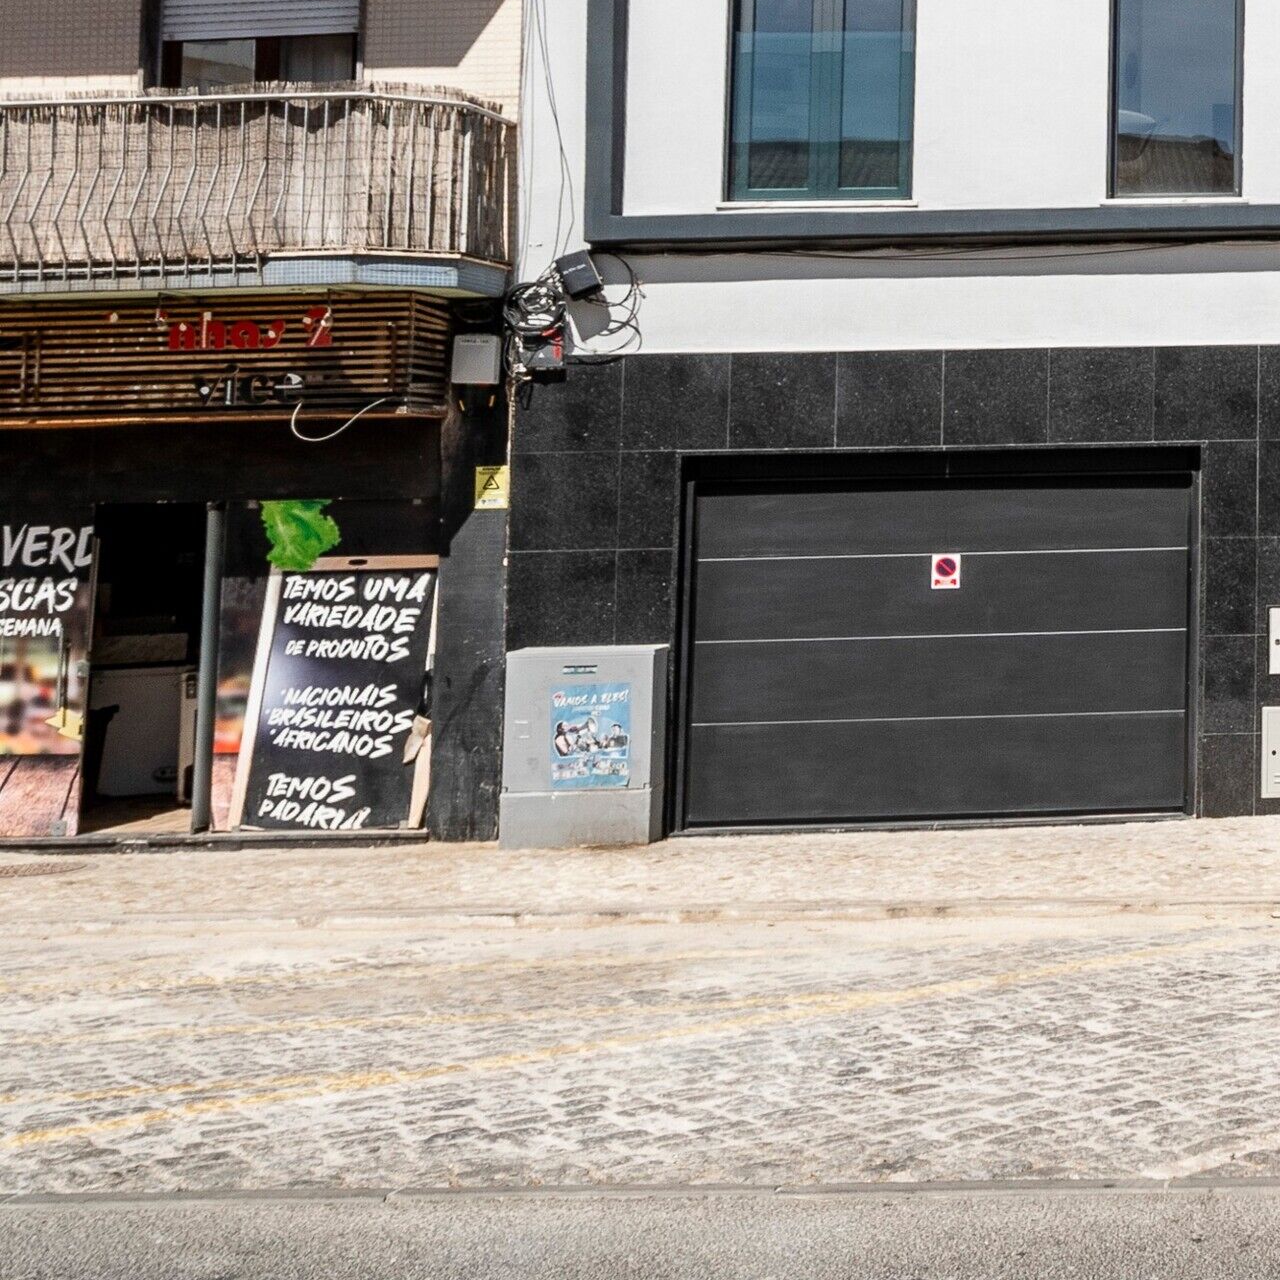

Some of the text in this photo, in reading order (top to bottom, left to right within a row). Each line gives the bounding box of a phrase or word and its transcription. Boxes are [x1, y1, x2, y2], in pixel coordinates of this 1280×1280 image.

[302, 306, 334, 348] 2
[283, 573, 431, 603] TEMOS UMA
[283, 601, 421, 634] VARIEDADE
[285, 634, 410, 663] DE PRODUTOS
[283, 683, 398, 709] NACIONAIS
[267, 707, 415, 734] BRASILEIROS
[272, 727, 394, 759] AFRICANOS
[266, 772, 357, 804] TEMOS
[257, 798, 372, 830] PADARIA
